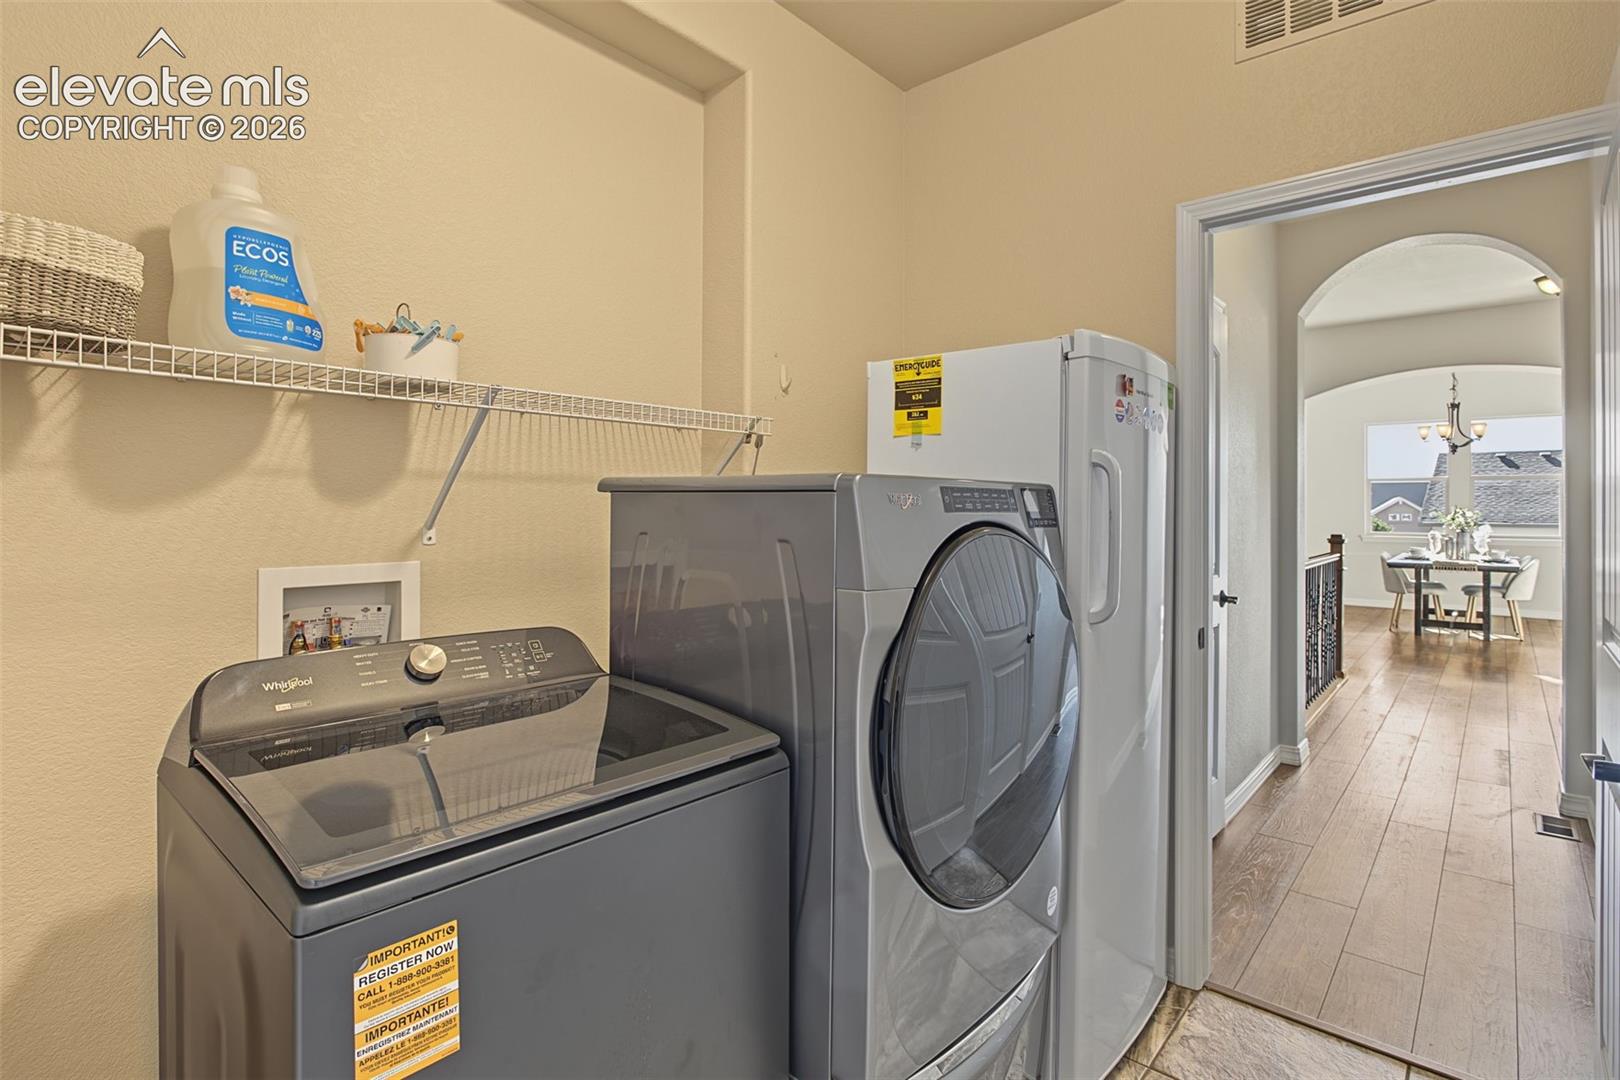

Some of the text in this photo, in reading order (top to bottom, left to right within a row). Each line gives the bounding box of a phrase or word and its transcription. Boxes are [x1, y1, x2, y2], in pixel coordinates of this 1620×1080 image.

[233, 240, 289, 266] ECOS
[262, 676, 313, 693] Whirlpool
[358, 940, 455, 988] REGISTER NOW
[370, 928, 446, 966] IMPORTANT!
[357, 985, 386, 1002] CALL
[388, 955, 455, 989] 1-888-900-3381
[356, 1028, 411, 1058] ENREGISTREZ
[412, 1005, 458, 1032] MAINTENANT
[365, 996, 449, 1043] IMPORTANTE!
[358, 1046, 394, 1067] APPELEZ
[395, 1040, 406, 1050] LE
